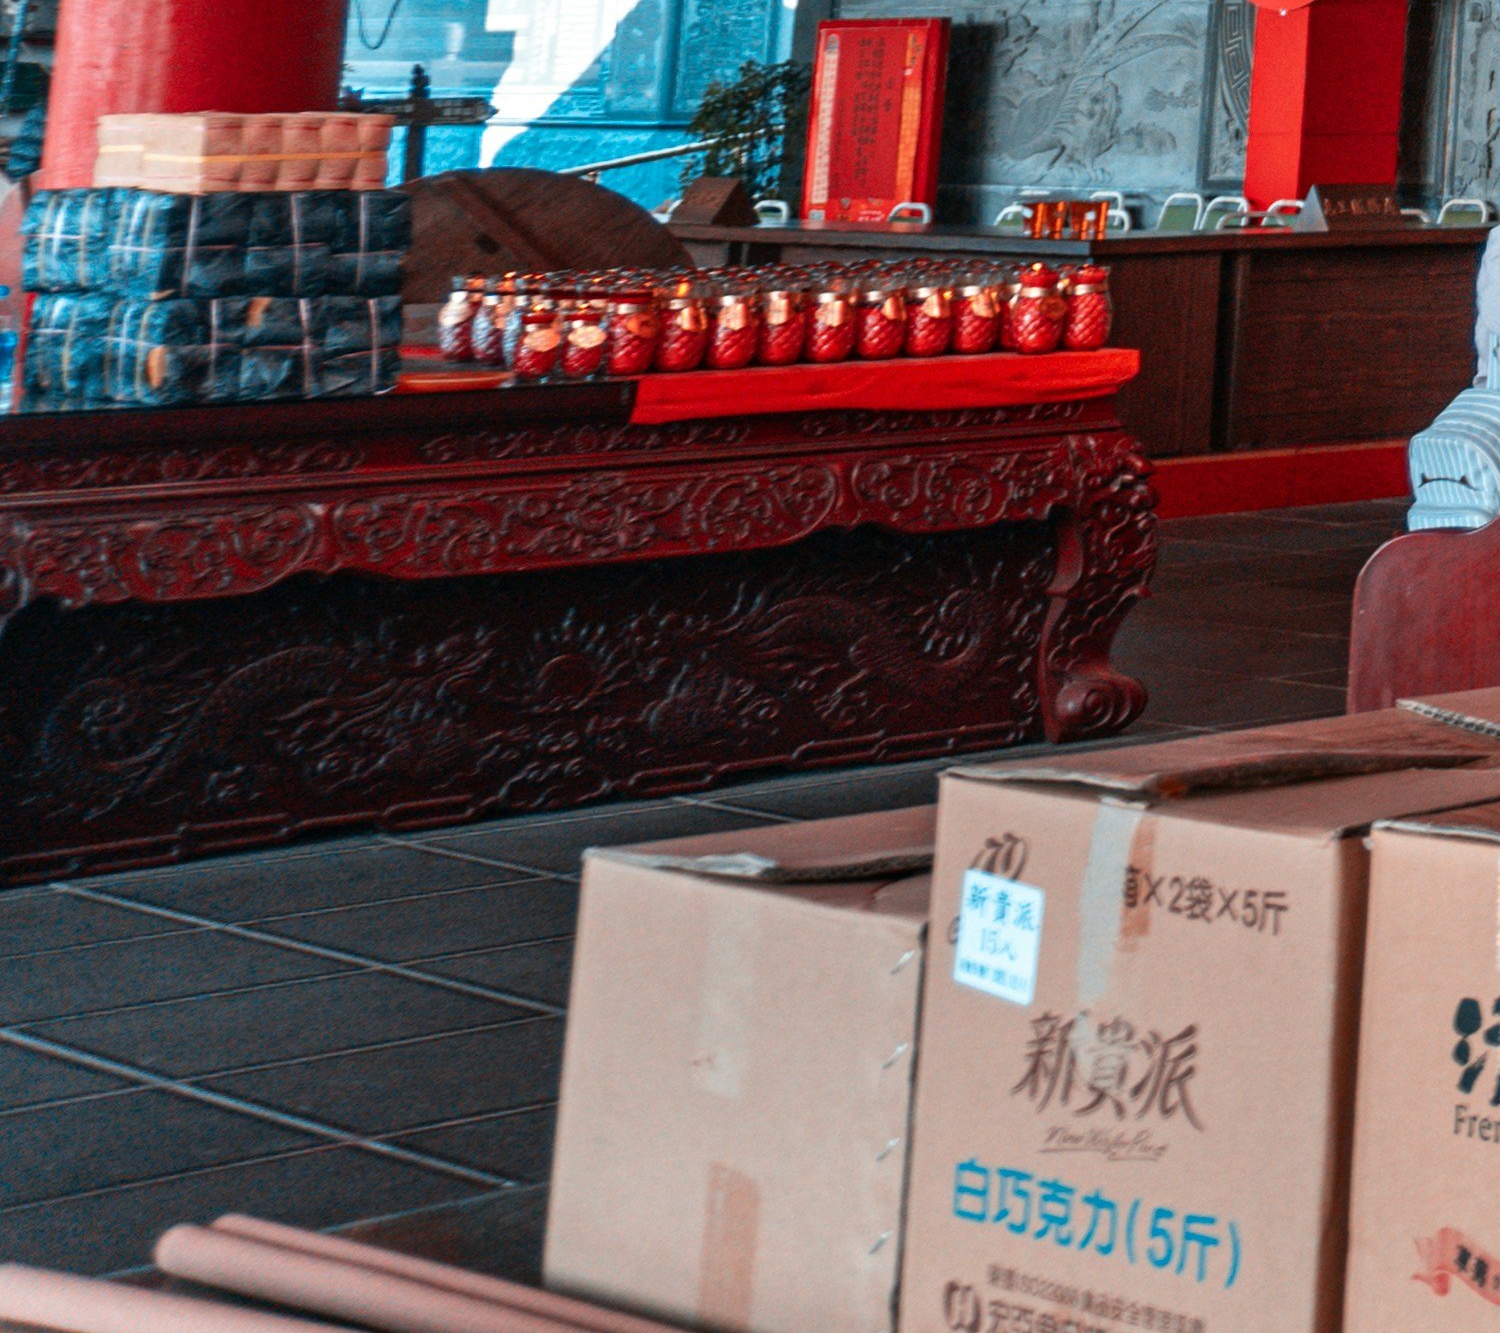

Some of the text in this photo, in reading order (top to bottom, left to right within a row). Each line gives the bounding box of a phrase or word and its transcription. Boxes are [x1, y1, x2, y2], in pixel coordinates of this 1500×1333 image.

[966, 885, 1038, 932] 新貴派
[1012, 1011, 1205, 1133] 新貴派
[952, 1159, 1243, 1290] 白巧克力(5斤)
